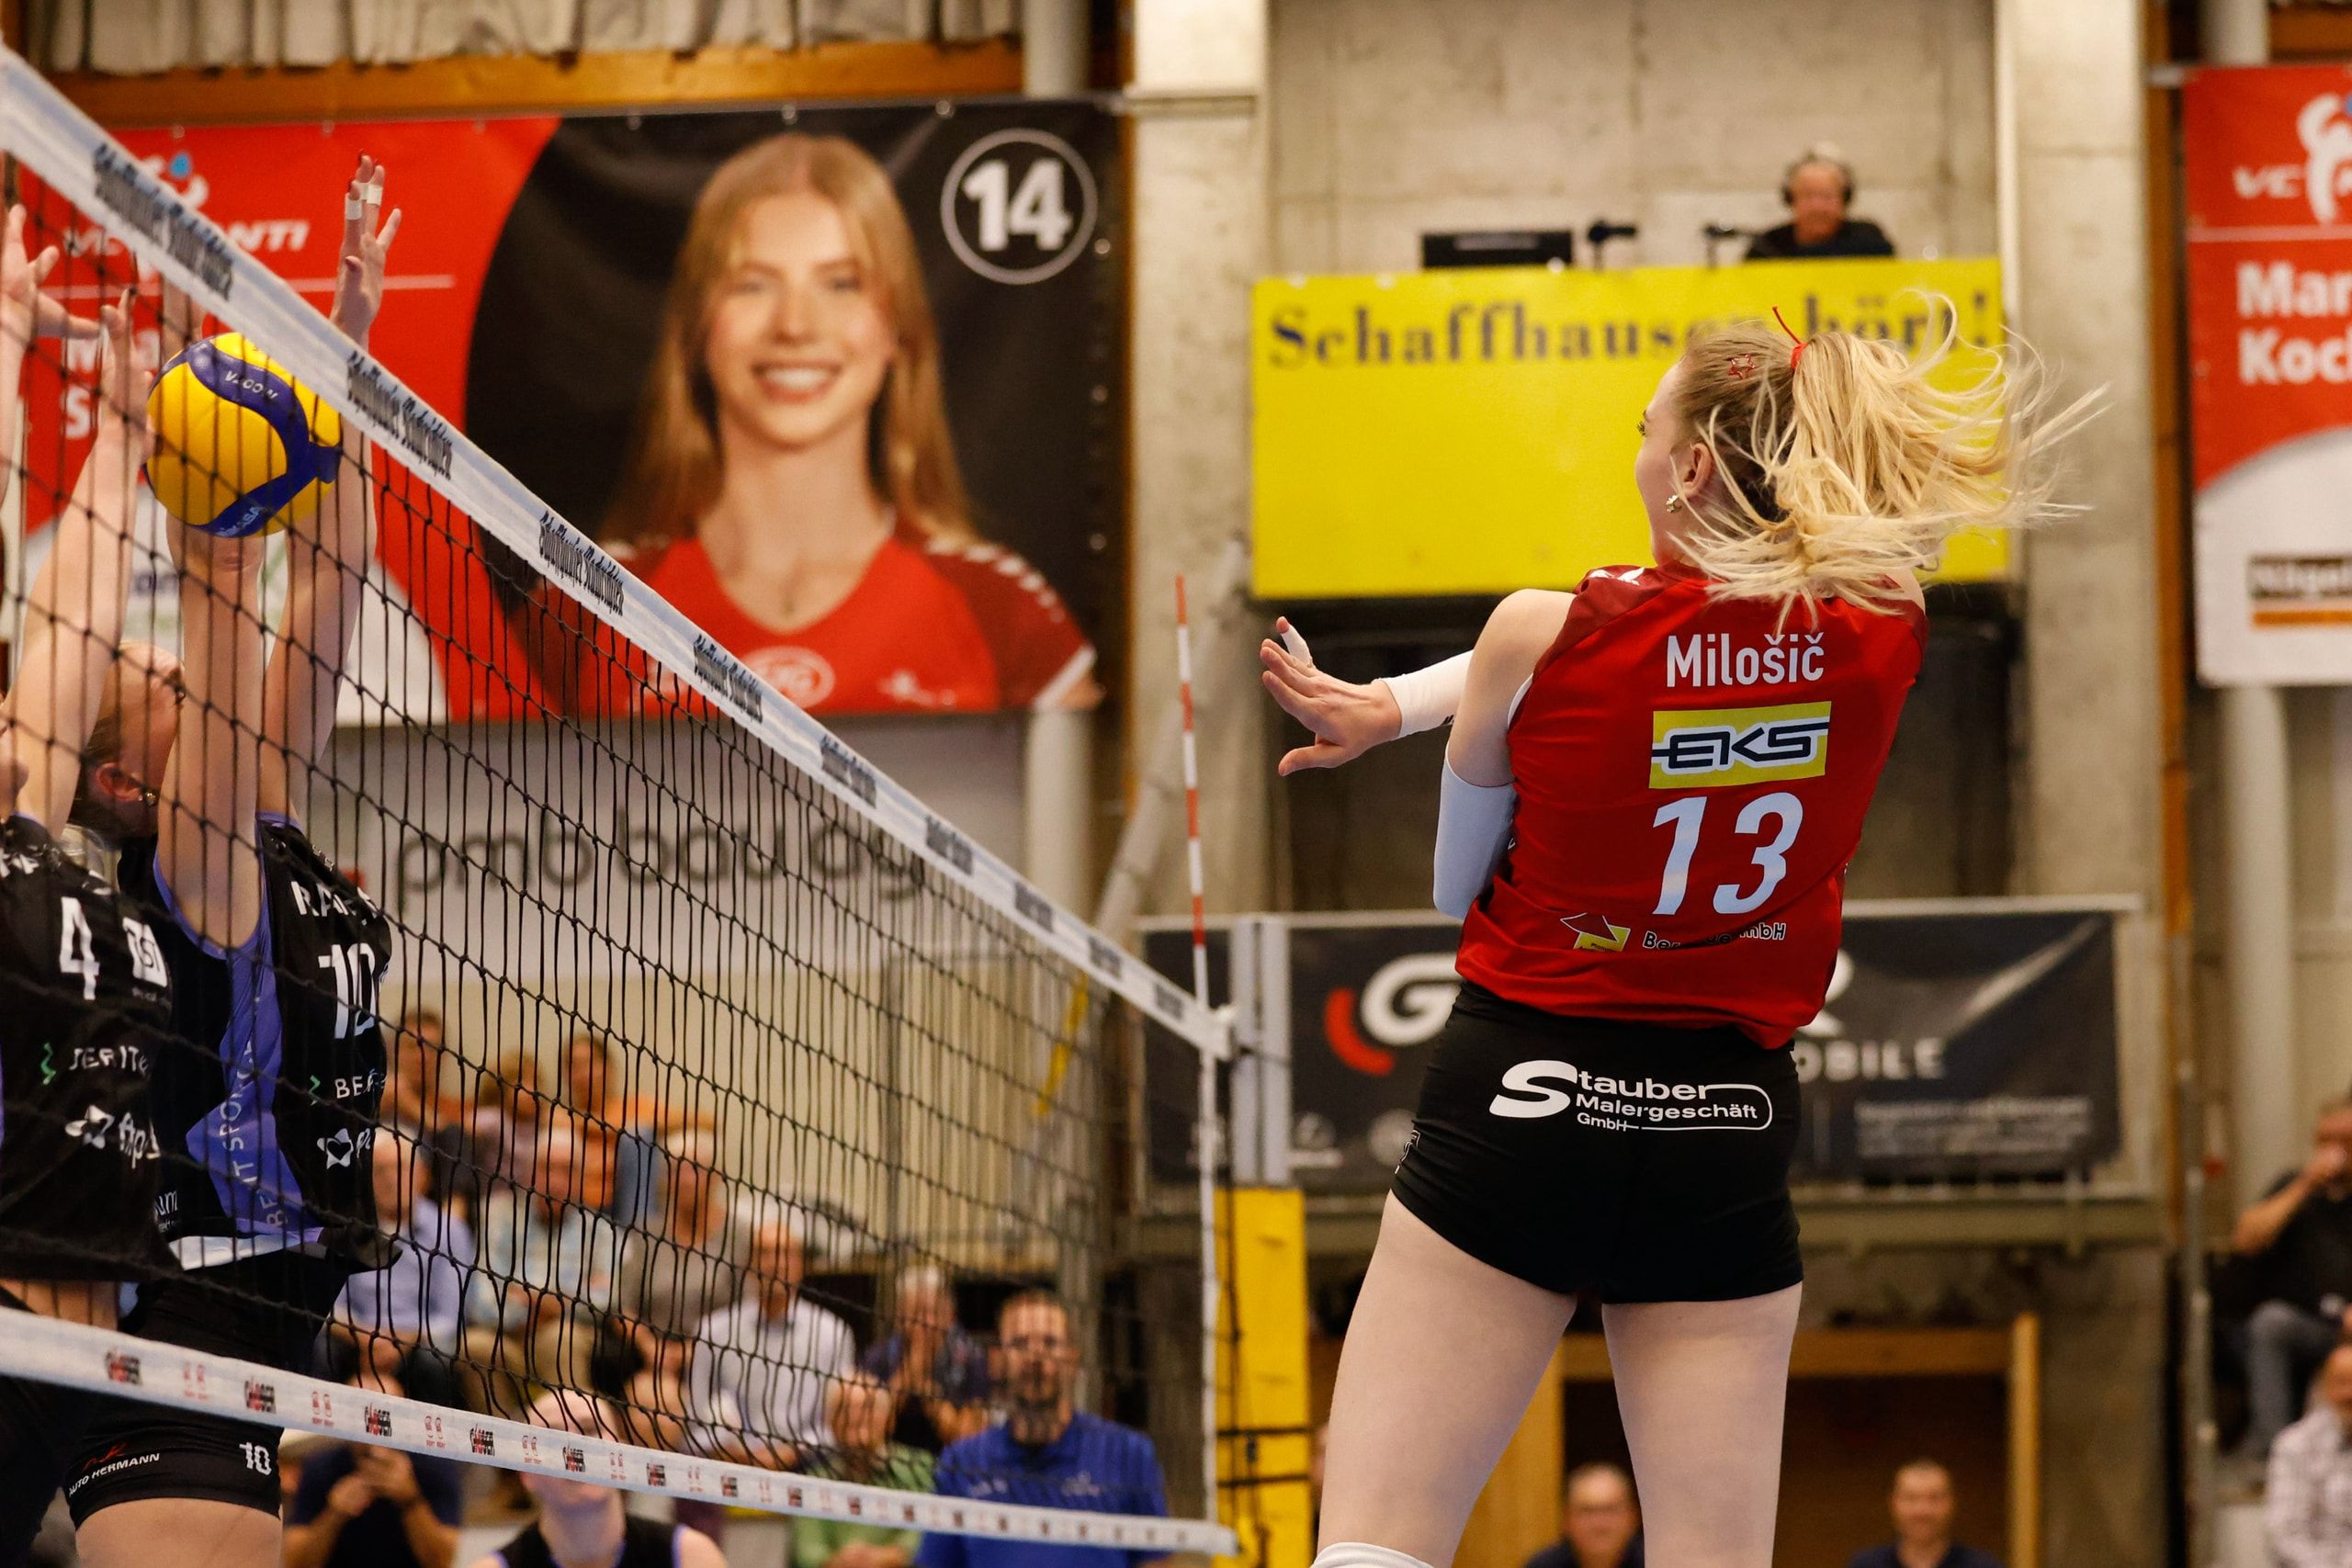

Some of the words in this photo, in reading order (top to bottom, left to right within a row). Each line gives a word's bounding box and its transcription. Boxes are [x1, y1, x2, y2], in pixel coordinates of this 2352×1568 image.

[963, 159, 1073, 252] 14
[1271, 299, 1707, 367] Schaffhaus
[1667, 632, 1825, 687] Milošič
[1659, 721, 1828, 770] EKS
[1653, 792, 1803, 915] 13
[59, 896, 100, 1000] 4
[318, 942, 377, 1039] 10
[1489, 1059, 1710, 1119] Stauber
[1576, 1093, 1758, 1122] Malergeschäft
[1577, 1111, 1629, 1133] GmbH
[69, 1475, 90, 1497] AUTO
[91, 1452, 161, 1480] HERMANN
[239, 1441, 273, 1476] 10
